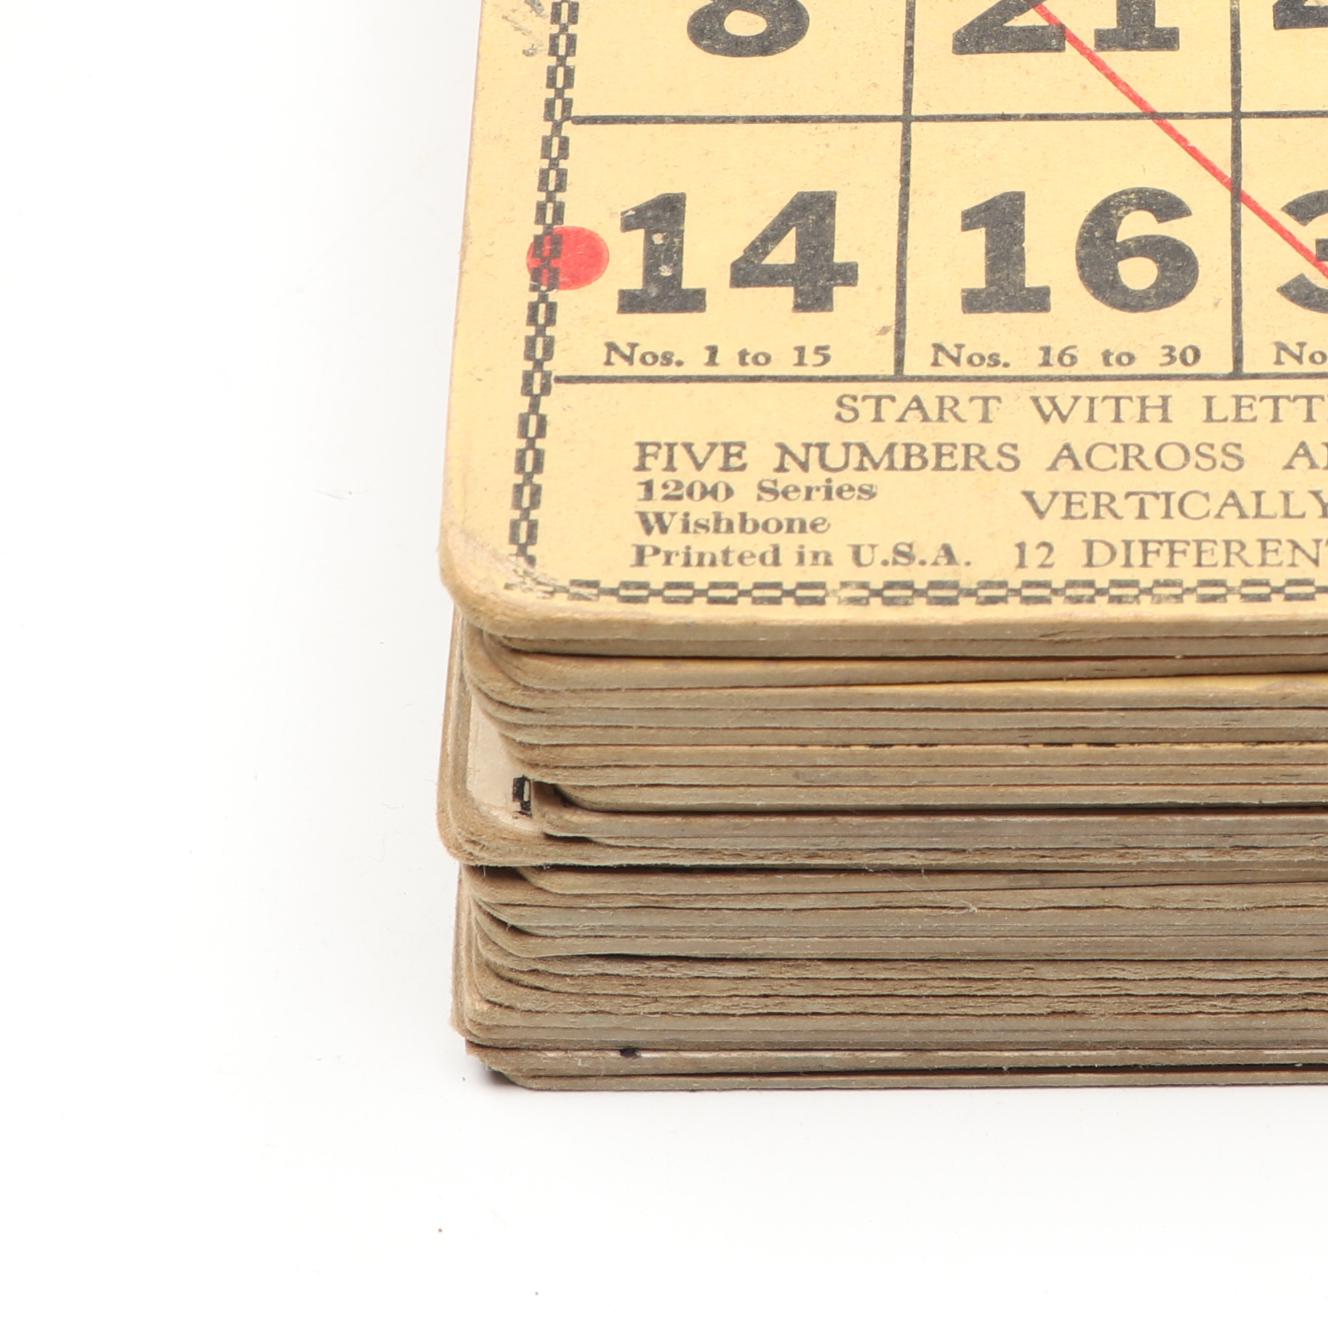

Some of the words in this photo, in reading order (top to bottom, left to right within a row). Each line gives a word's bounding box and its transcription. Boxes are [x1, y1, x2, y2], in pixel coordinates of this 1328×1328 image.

[617, 190, 859, 315] 14
[960, 186, 1200, 315] 16
[603, 341, 685, 368] Nos.
[704, 344, 719, 367] 1
[737, 347, 772, 367] to
[793, 344, 832, 368] 15
[930, 342, 1011, 369] Nos.
[1038, 344, 1078, 368] 16
[1101, 348, 1137, 368] to
[1159, 344, 1202, 367] 30
[834, 393, 1002, 424] START
[1029, 394, 1173, 424] WITH
[632, 440, 748, 473] FIVE
[772, 441, 1021, 474] NUMBERS
[1045, 441, 1245, 472] ACROSS
[637, 478, 735, 502] 1200
[756, 477, 878, 502] Series
[635, 510, 828, 537] Wishbone
[630, 543, 782, 568] Printed
[796, 544, 834, 567] in
[851, 541, 972, 568] U.S.A.
[1014, 540, 1055, 570] 12
